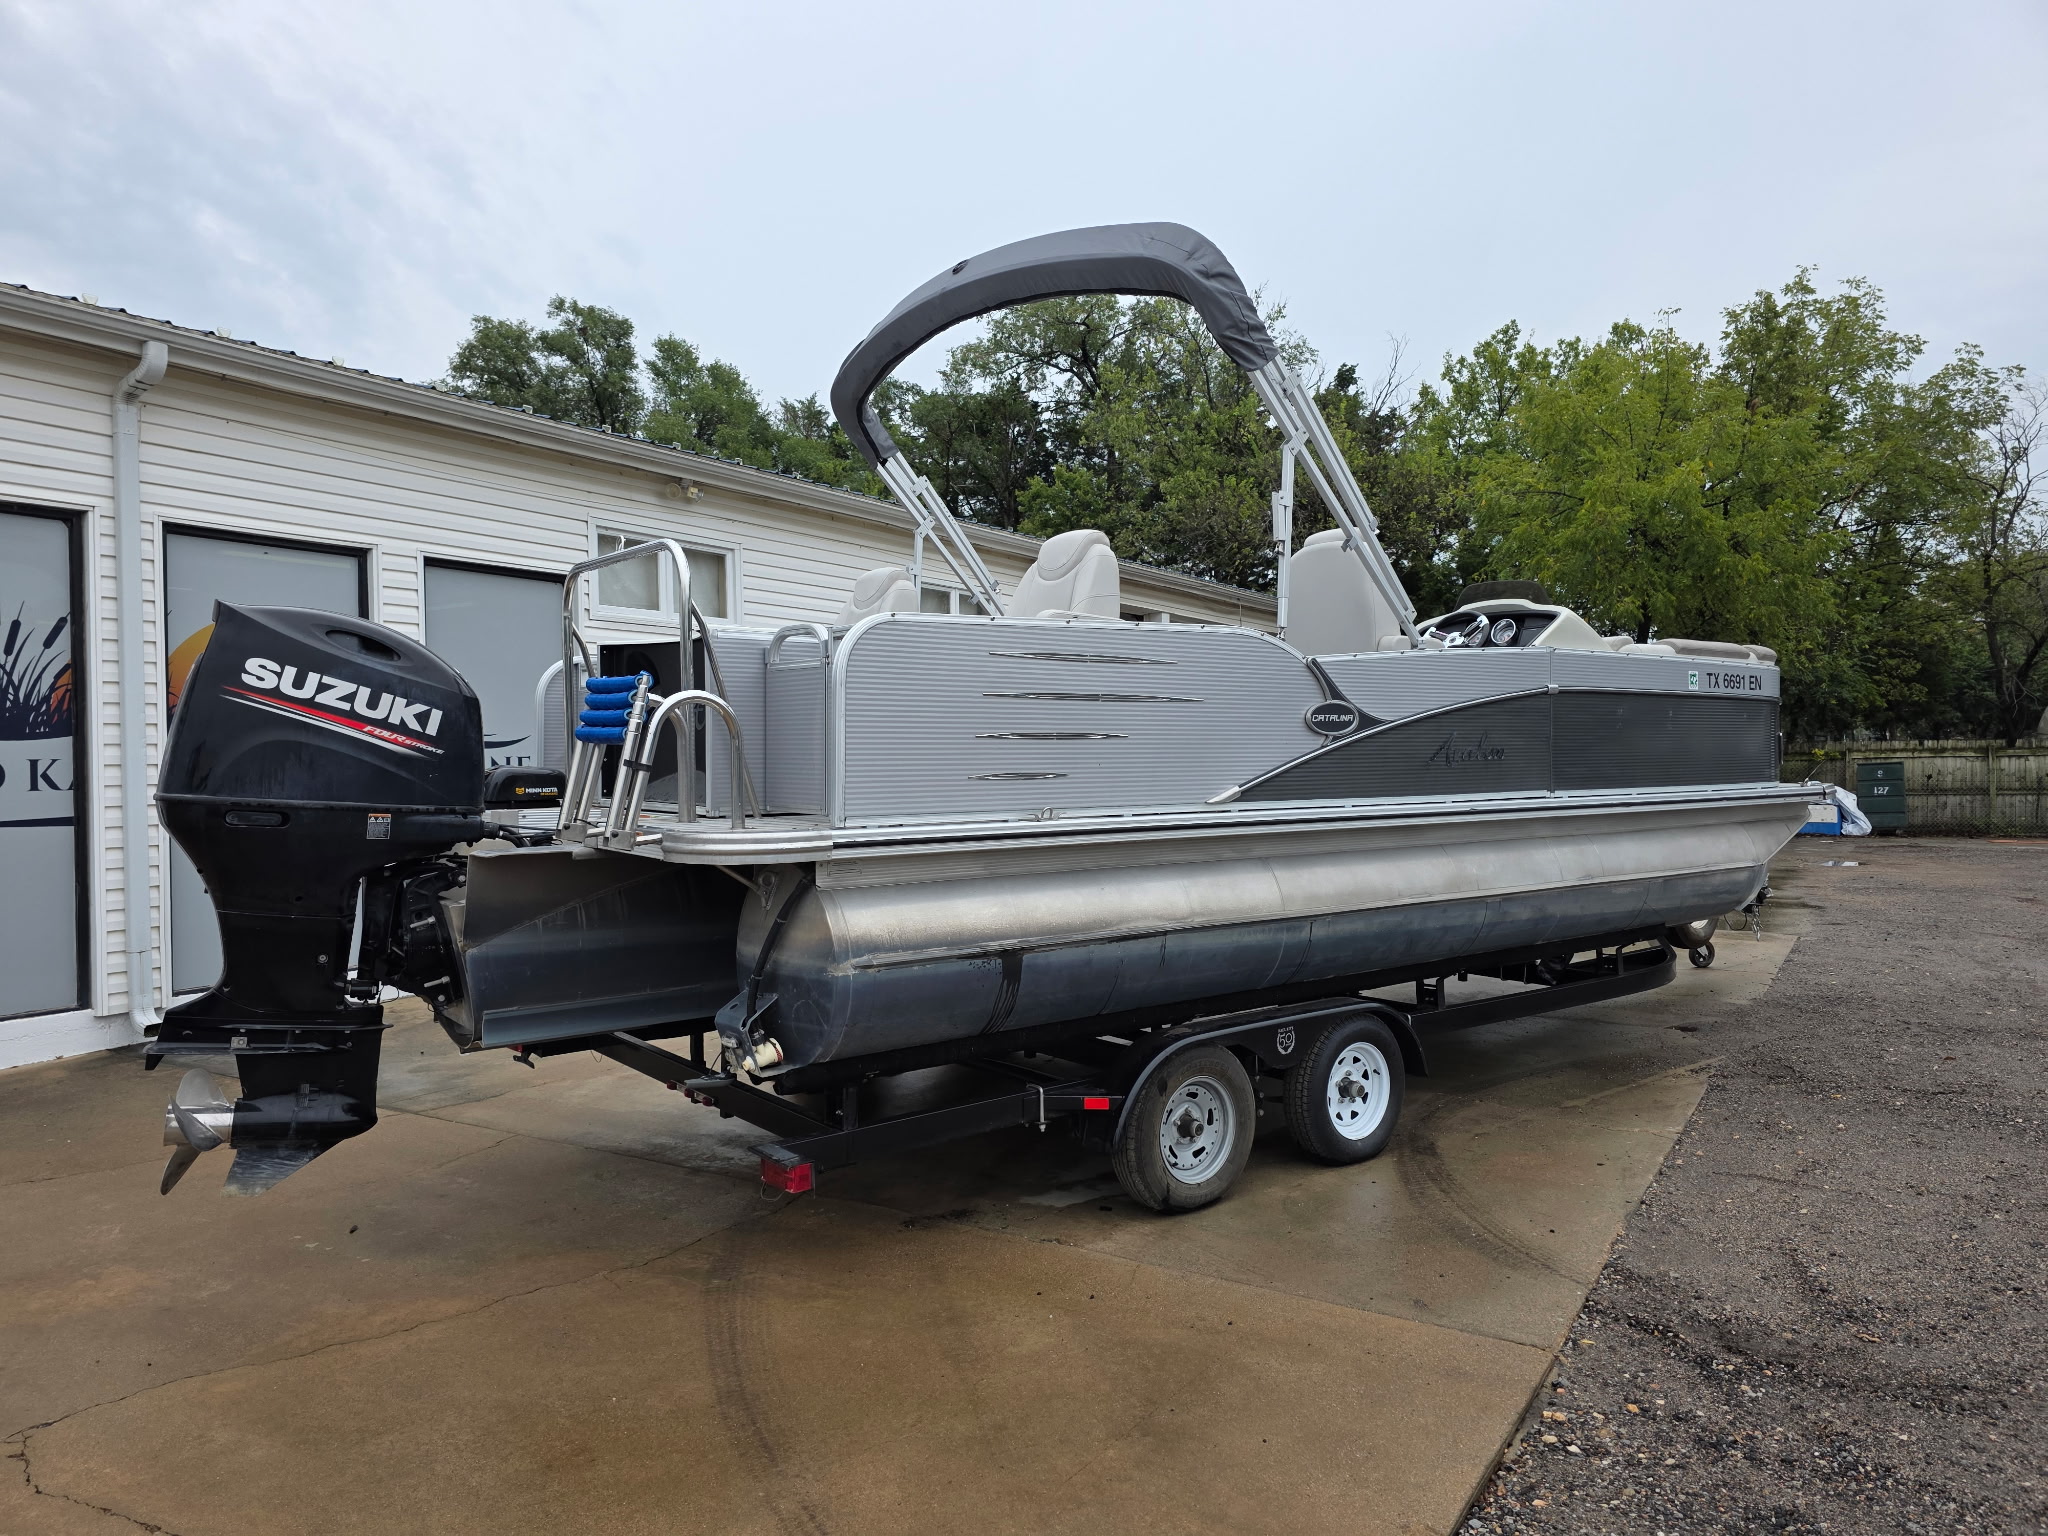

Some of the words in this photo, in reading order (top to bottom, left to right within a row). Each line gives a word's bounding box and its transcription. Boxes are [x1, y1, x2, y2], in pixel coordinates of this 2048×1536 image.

[1706, 672, 1720, 689] TX
[1723, 673, 1746, 690] 6691
[1749, 675, 1762, 691] EN
[241, 657, 443, 737] SUZUKI
[1311, 714, 1354, 722] CATALINA
[1873, 786, 1890, 795] 127
